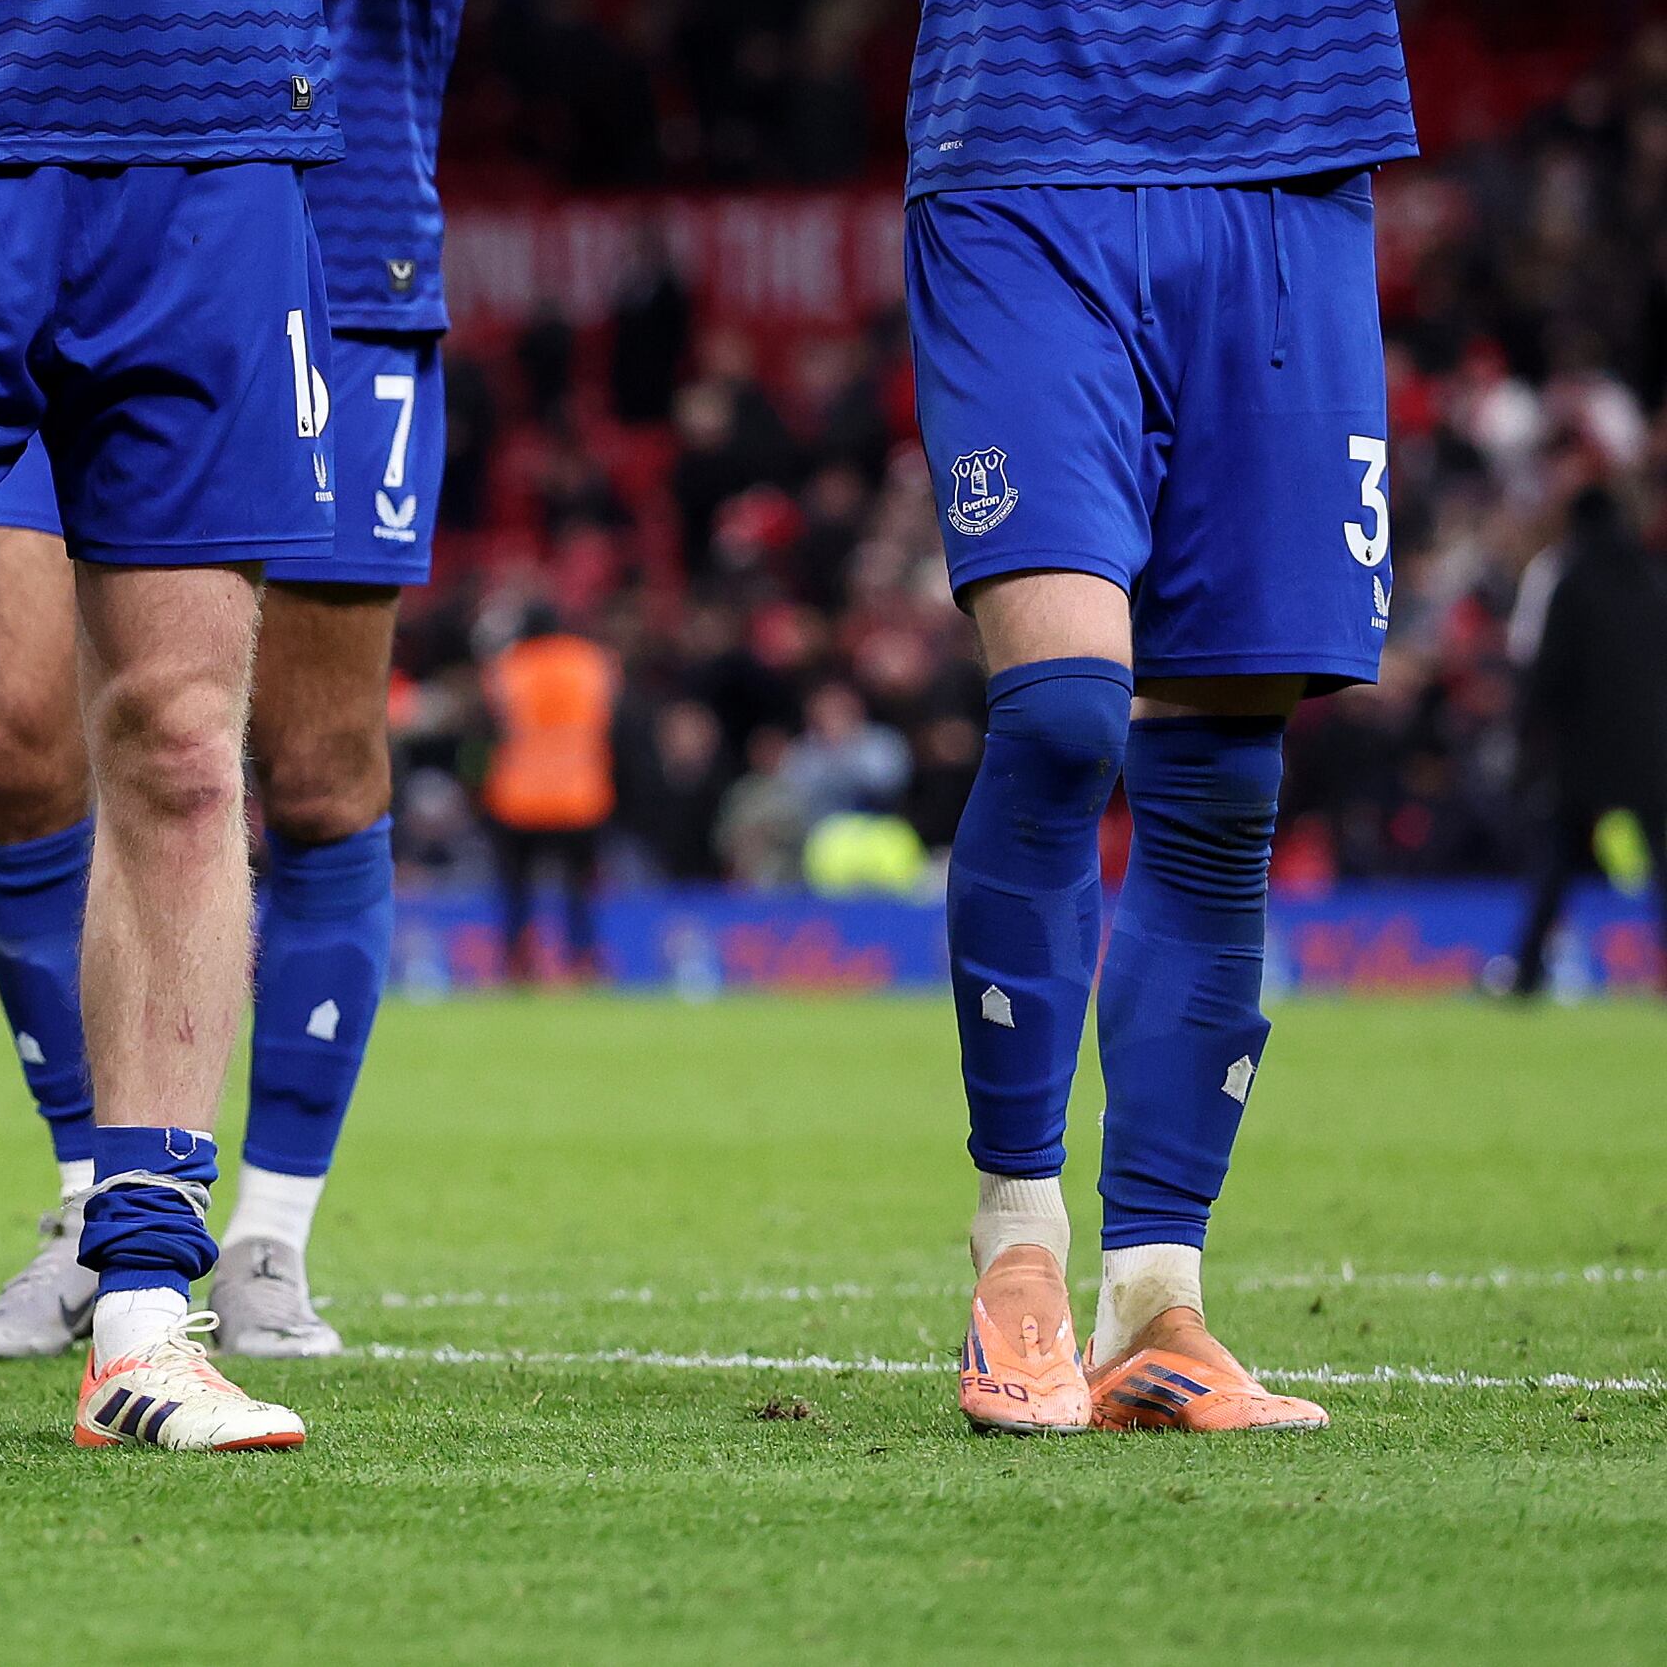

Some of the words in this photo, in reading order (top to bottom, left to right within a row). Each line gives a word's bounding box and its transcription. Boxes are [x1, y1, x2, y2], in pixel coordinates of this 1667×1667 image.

[374, 374, 415, 487] 7
[962, 495, 1000, 514] Everton
[961, 1376, 1029, 1403] F50
